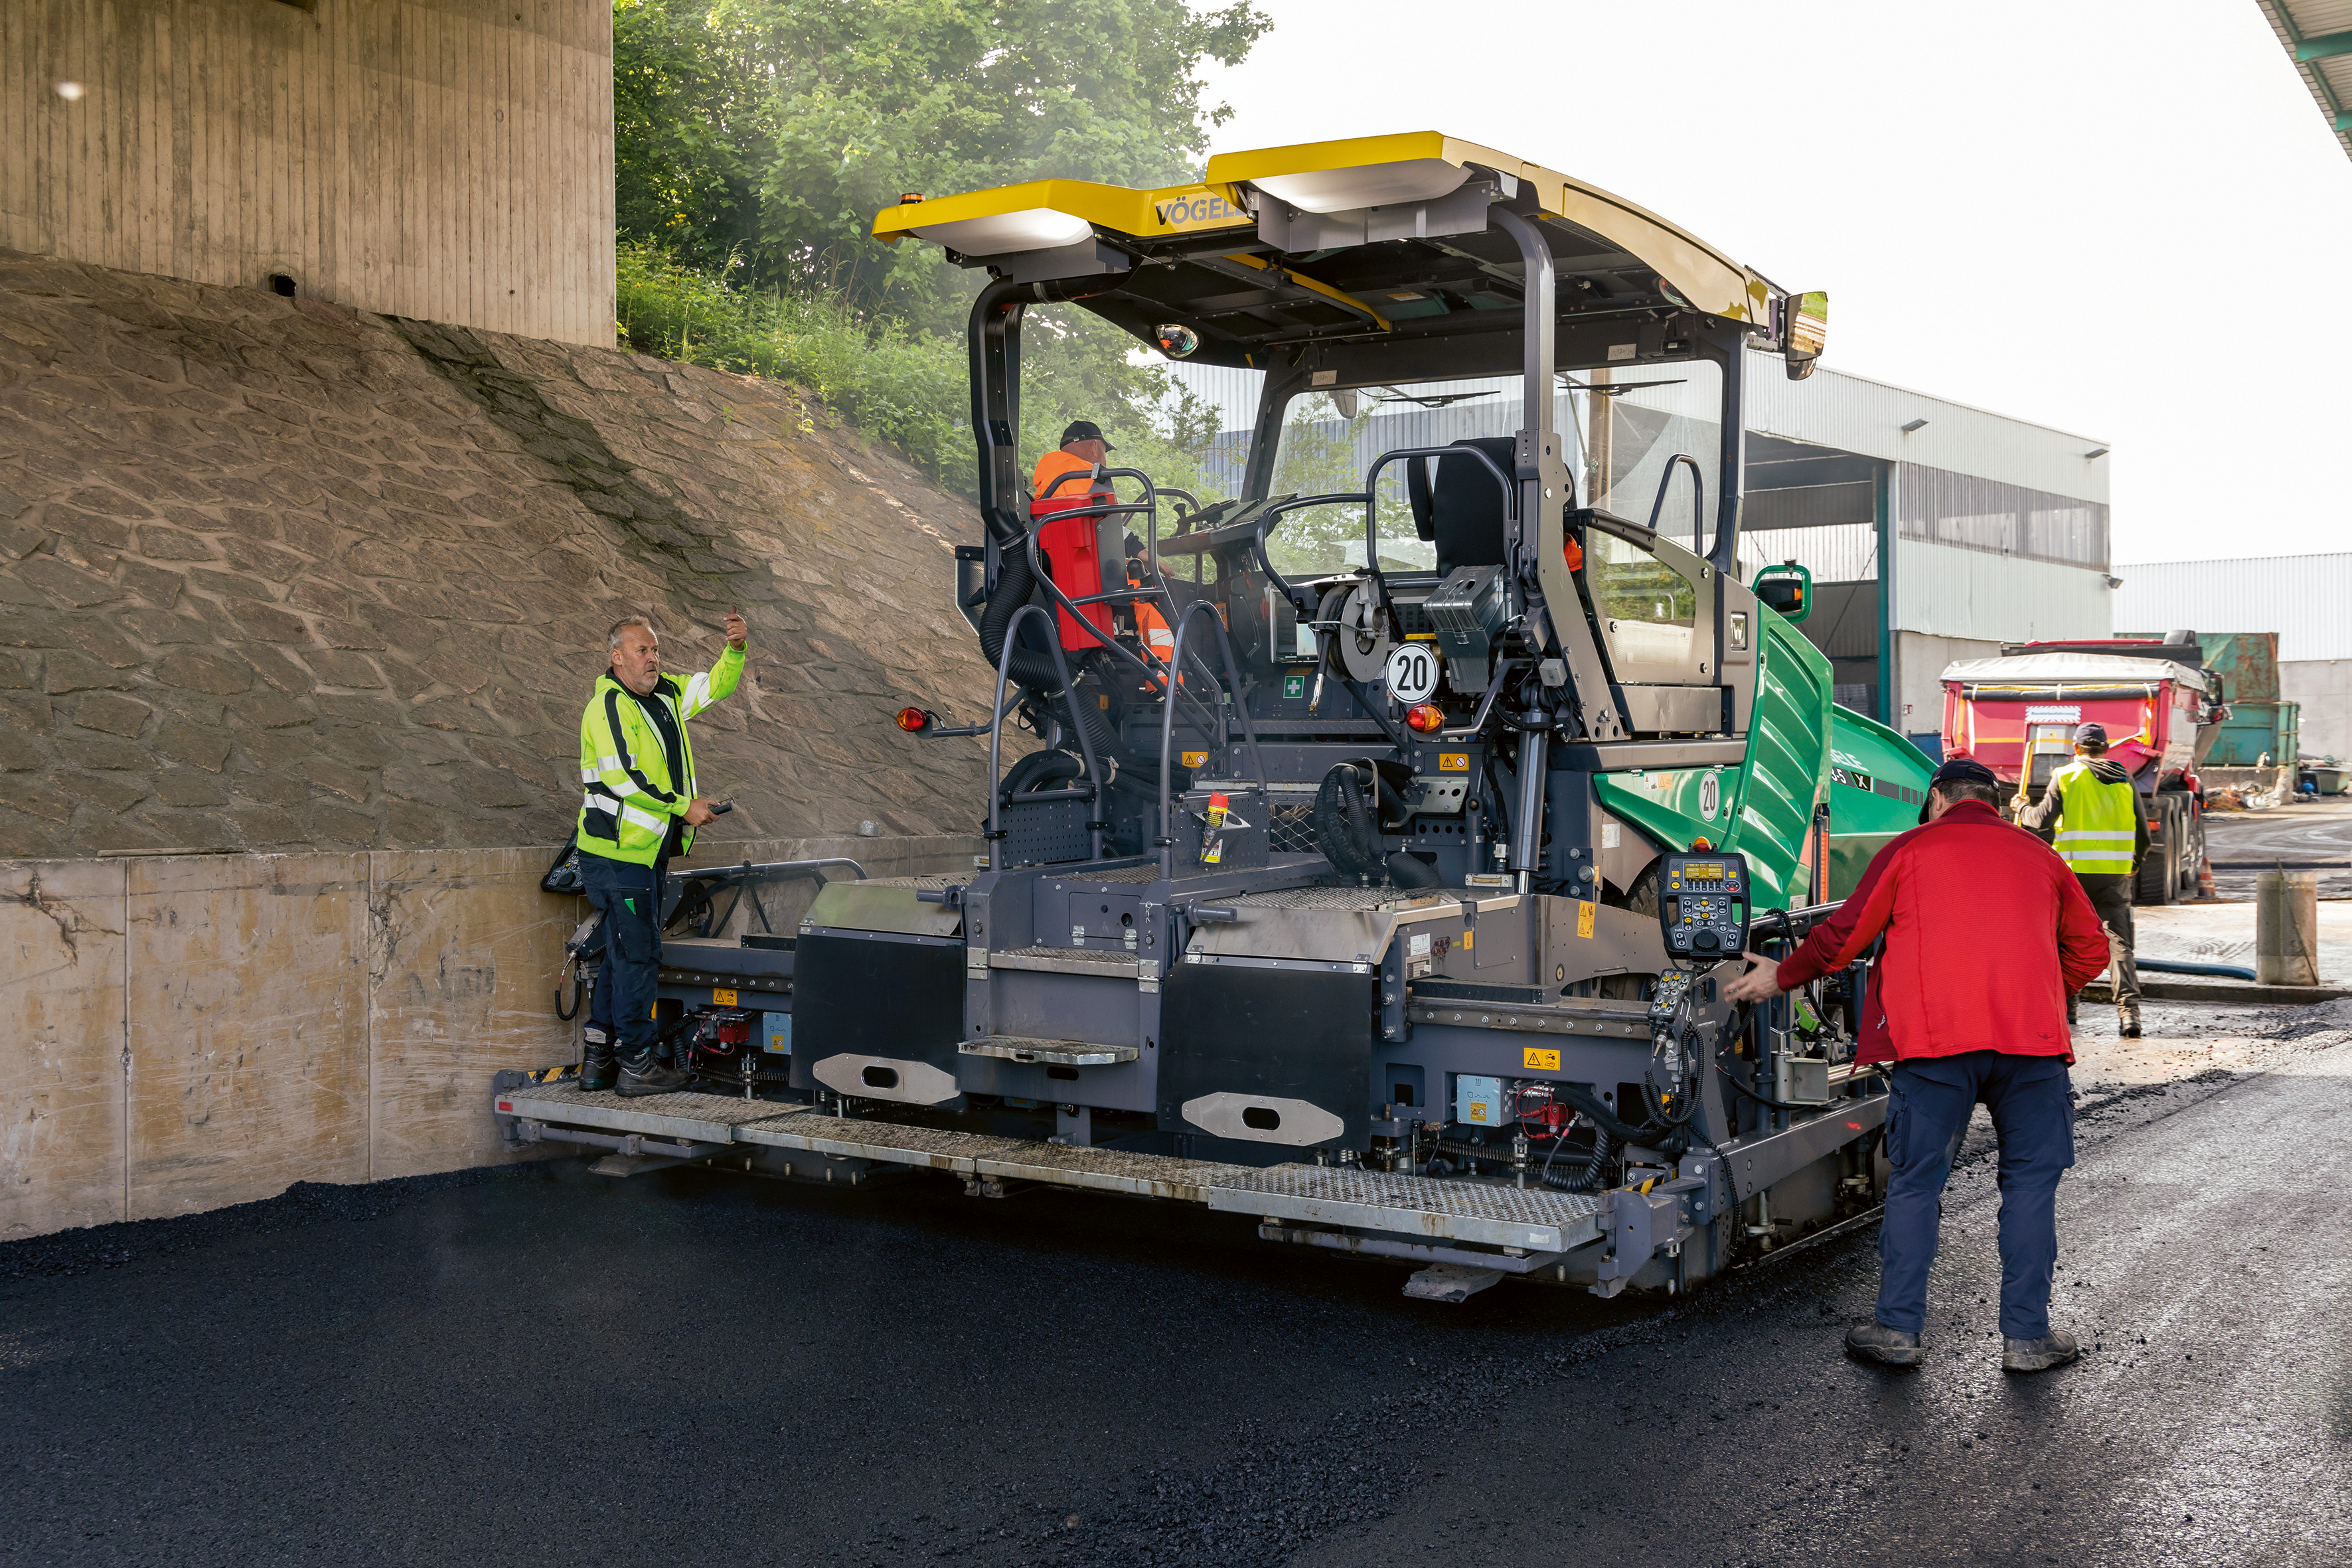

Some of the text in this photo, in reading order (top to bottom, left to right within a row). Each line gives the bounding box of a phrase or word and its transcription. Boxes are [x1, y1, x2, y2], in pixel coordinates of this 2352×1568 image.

[1156, 196, 1245, 226] VÖGEL
[1397, 655, 1427, 692] 20
[1703, 780, 1716, 812] 20
[1854, 773, 1869, 789] X
